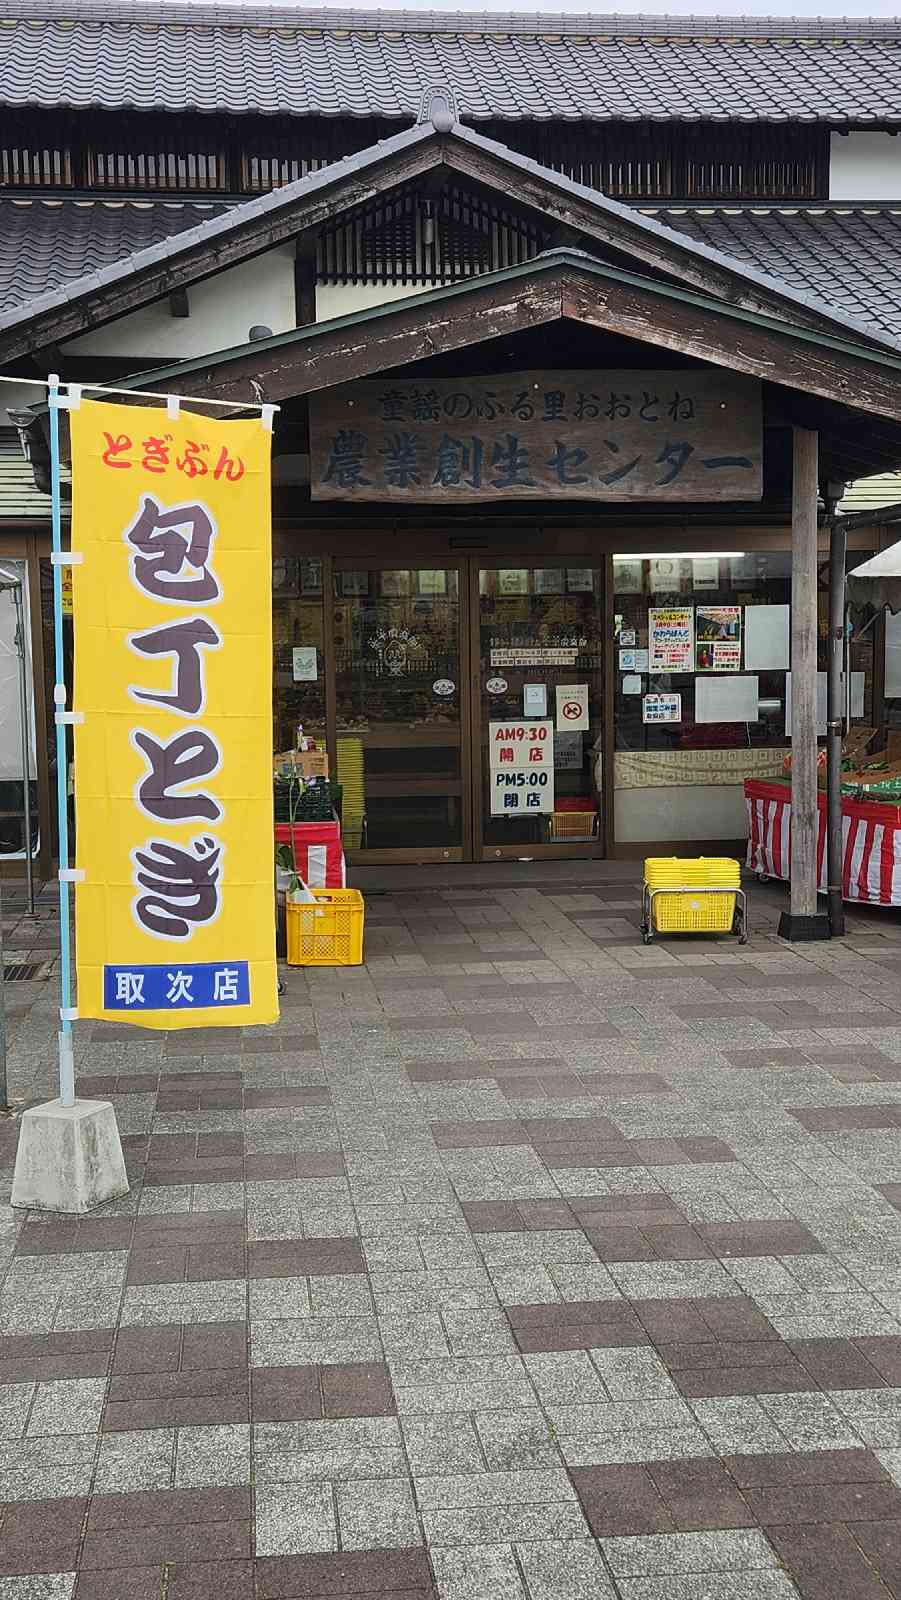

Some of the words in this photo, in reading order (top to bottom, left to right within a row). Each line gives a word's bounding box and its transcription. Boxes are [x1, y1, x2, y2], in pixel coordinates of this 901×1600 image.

[379, 388, 696, 423] 童謡のふる里おおとね
[101, 431, 245, 482] とぎぶん
[321, 430, 754, 489] 農業創生センター
[124, 495, 222, 938] 包丁とぎ
[495, 727, 547, 742] AM9:30
[499, 747, 544, 763] 開店
[496, 772, 548, 787] PM5:00
[503, 792, 541, 808] 閉店
[115, 967, 239, 1005] 取次店
